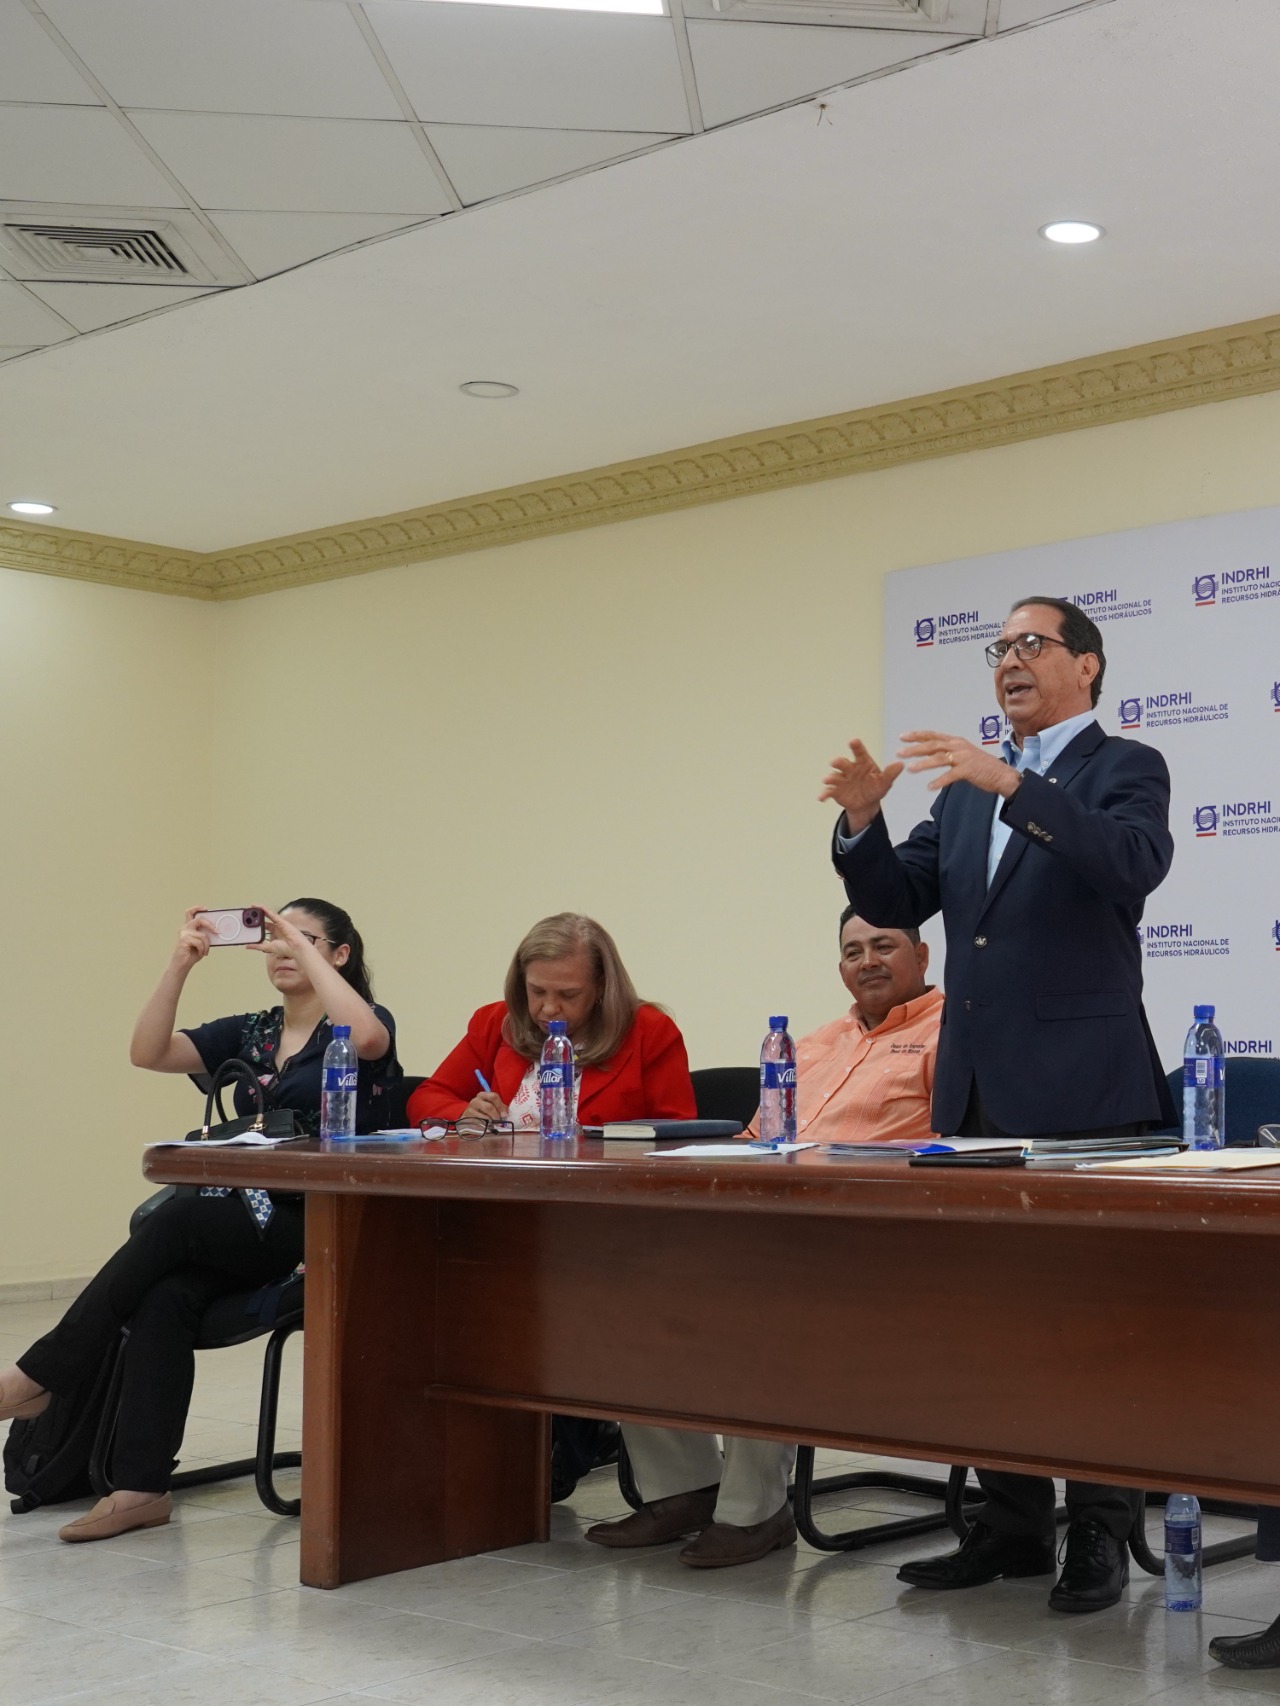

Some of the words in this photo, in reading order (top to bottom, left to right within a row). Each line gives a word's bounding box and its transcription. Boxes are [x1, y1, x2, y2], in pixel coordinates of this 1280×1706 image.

[1222, 566, 1268, 584] INDRHI
[1222, 583, 1257, 595] INSTITUTO
[1074, 589, 1116, 607] INDRHI
[1222, 592, 1258, 603] RECURSOS
[939, 610, 978, 627] INDRHI
[1146, 691, 1191, 708] INDRHI
[1146, 708, 1180, 718] INSTITUTO
[1182, 704, 1217, 714] NACIONAL
[1146, 717, 1181, 727] RECURSOS
[1223, 800, 1270, 816] INDRHI
[1223, 818, 1259, 827] INSTITUTO
[1223, 827, 1260, 836] RECURSOS
[1147, 924, 1192, 938] INDRHI
[1147, 940, 1181, 948] INSTITUTO
[1183, 939, 1218, 947] NACIONAL
[1147, 949, 1182, 957] RECURSOS
